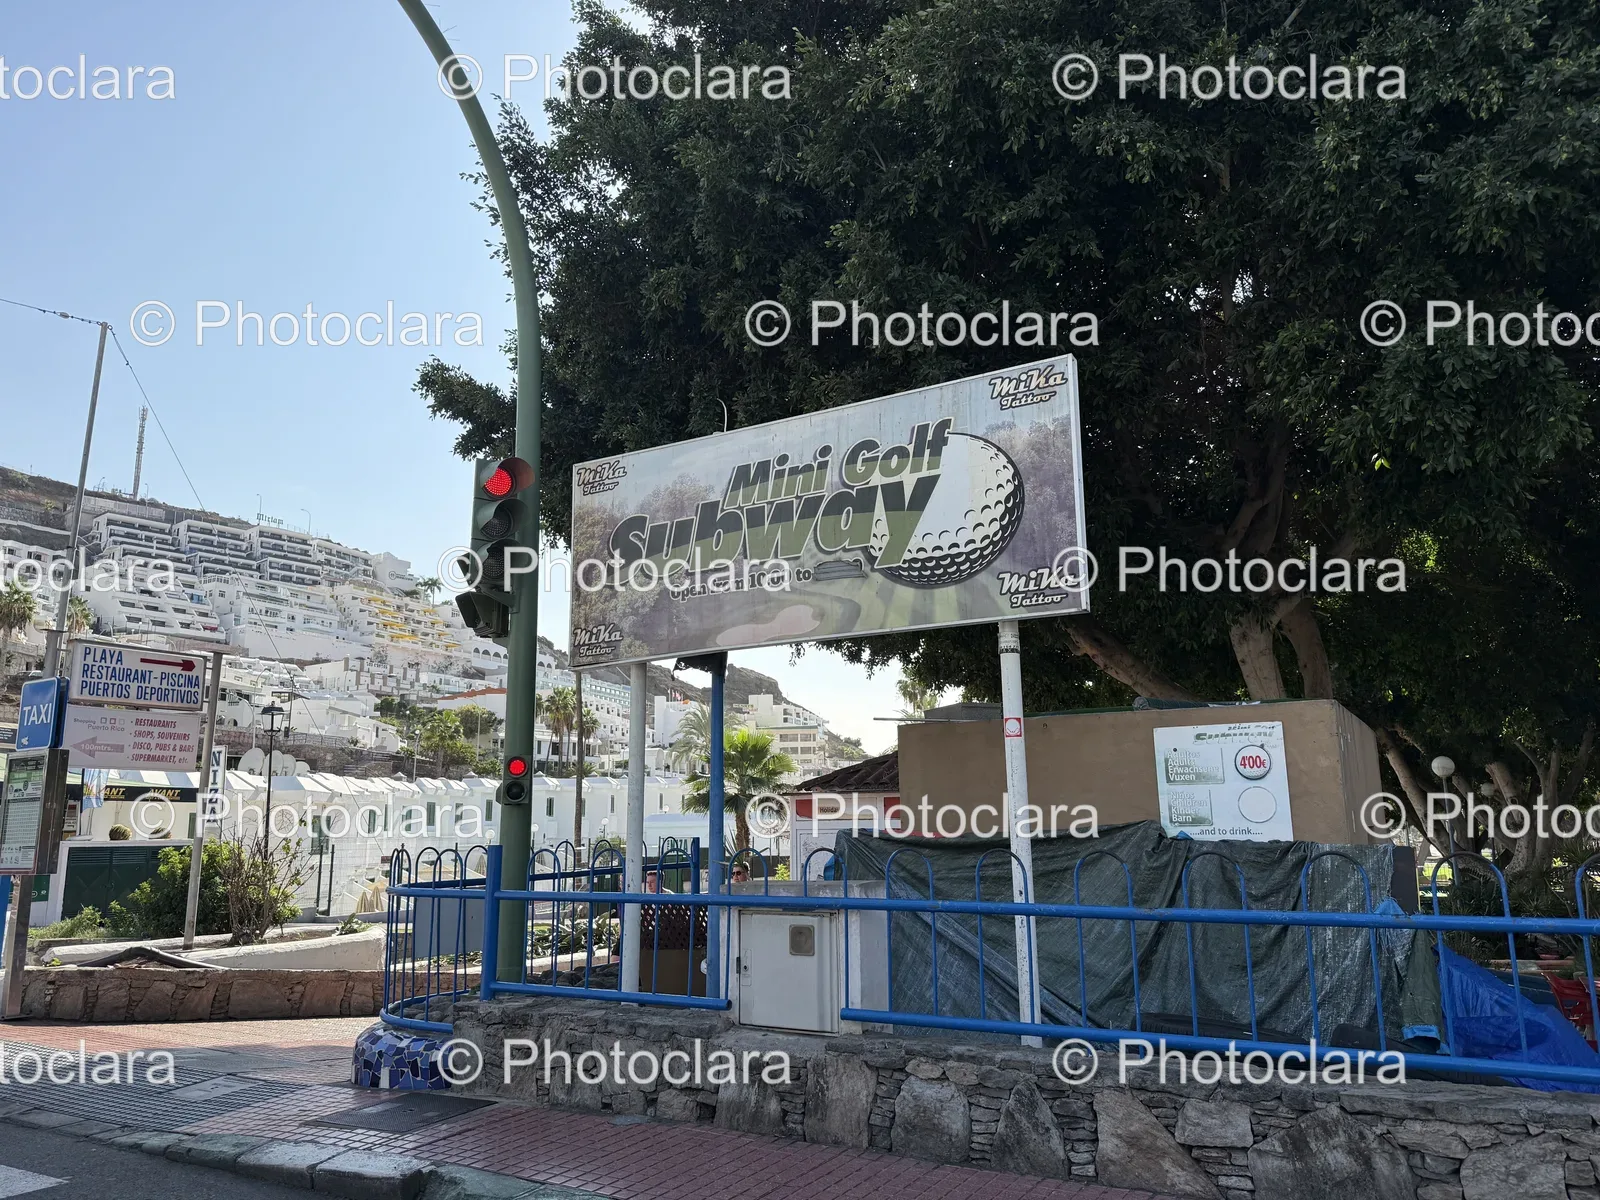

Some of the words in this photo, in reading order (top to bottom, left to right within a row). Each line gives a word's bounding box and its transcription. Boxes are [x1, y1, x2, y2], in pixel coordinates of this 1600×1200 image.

[1000, 391, 1057, 411] Tattoo
[723, 444, 833, 509] Mini
[841, 416, 954, 486] Golf
[583, 481, 619, 496] Tattoo
[602, 474, 942, 586] Subway
[670, 583, 708, 603] Open
[710, 577, 744, 595] from
[795, 568, 812, 582] to
[1010, 592, 1068, 609] Tattoo
[83, 647, 123, 665] PLAYA
[579, 645, 616, 658] Tattoo
[80, 680, 131, 699] PUERTOS
[136, 686, 199, 704] DEPORTIVOS
[23, 703, 52, 726] TAXI
[110, 724, 125, 732] Rico
[135, 718, 177, 729] RESTAURANTS
[133, 730, 155, 740] SHOPS,
[157, 731, 190, 741] SOUVENIRS
[132, 742, 153, 751] DISCO,
[154, 743, 171, 752] PUBS
[178, 744, 194, 753] BARS
[1168, 758, 1195, 766] Adults
[1169, 773, 1196, 781] Vuxen
[103, 787, 125, 796] ANT
[1171, 799, 1208, 807] Children
[1172, 814, 1192, 822] Barn
